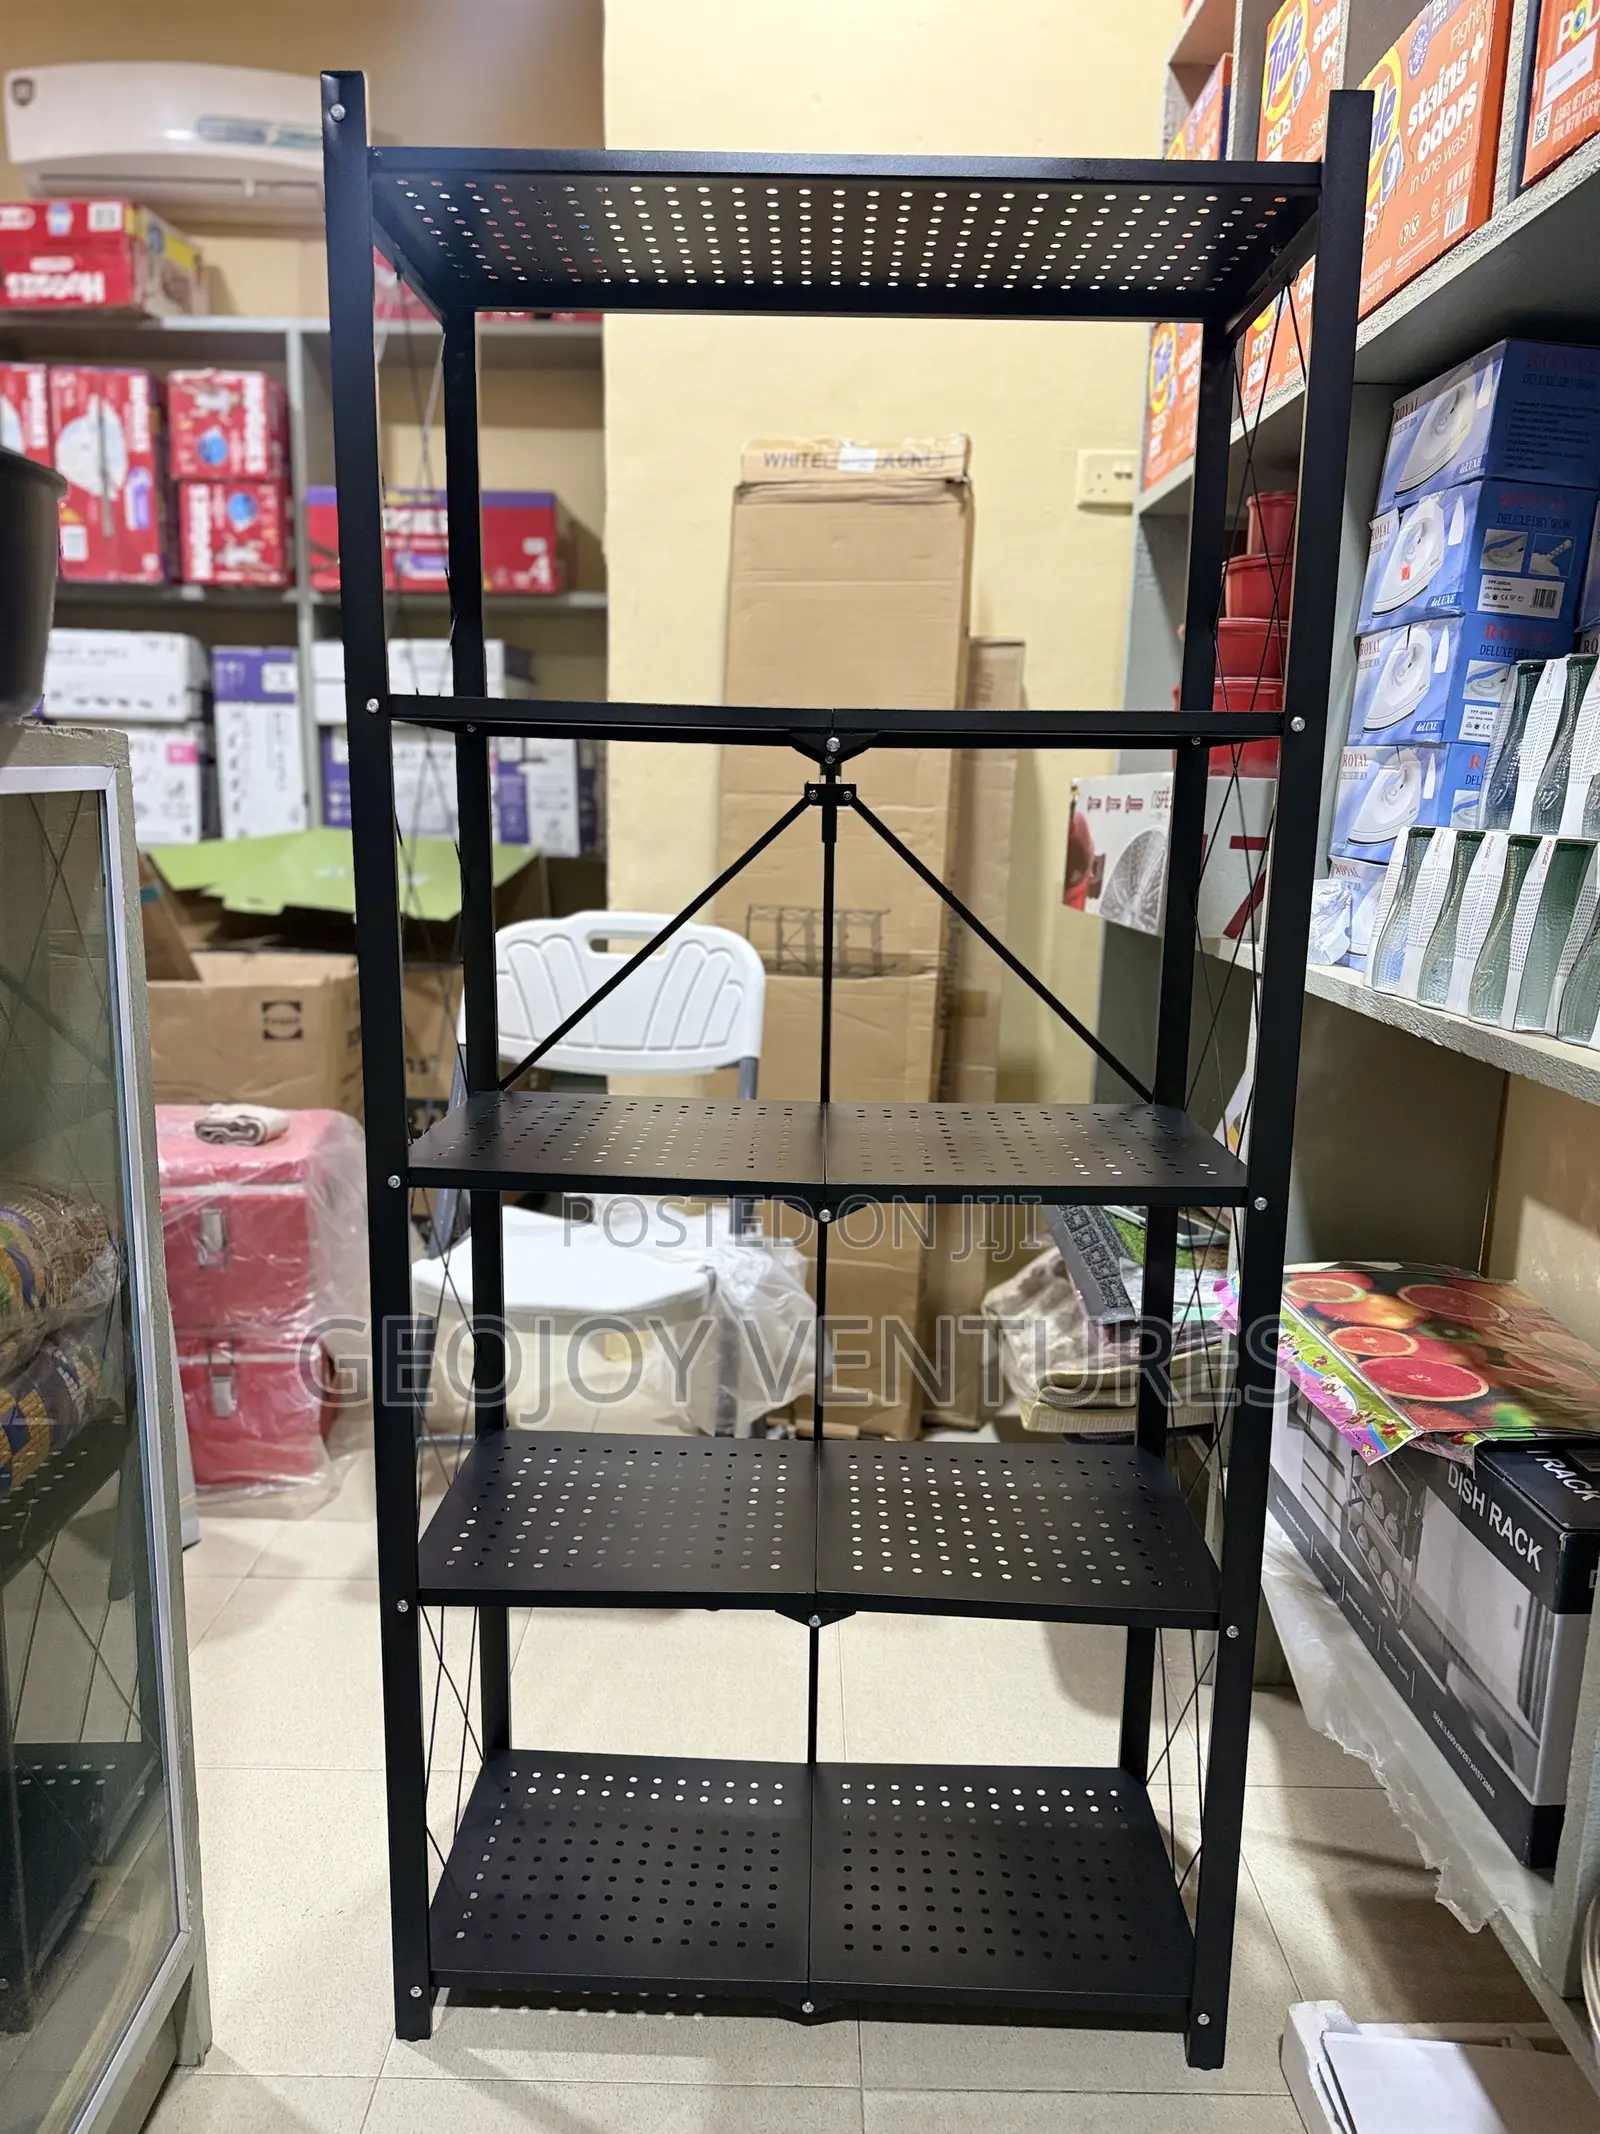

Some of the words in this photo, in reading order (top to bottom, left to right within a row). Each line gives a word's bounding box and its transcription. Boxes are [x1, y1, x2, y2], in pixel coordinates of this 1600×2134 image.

[1265, 4, 1304, 113] Tide
[1407, 50, 1468, 136] stains
[1417, 81, 1478, 163] odors
[1410, 174, 1419, 196] in
[1421, 155, 1441, 186] one
[1443, 121, 1473, 164] wash
[1395, 397, 1419, 424] ROYAL
[764, 452, 822, 468] WHITE
[1372, 520, 1390, 541] ROYAL
[1431, 594, 1457, 608] deLUXE
[1360, 640, 1380, 657] ROYAL
[1479, 644, 1513, 658] DELUXE
[1416, 721, 1438, 731] deLUXE
[1343, 753, 1368, 767] ROYAL
[1535, 1458, 1600, 1501] RACK
[1448, 1462, 1486, 1517] DISH
[1489, 1502, 1542, 1572] RACK
